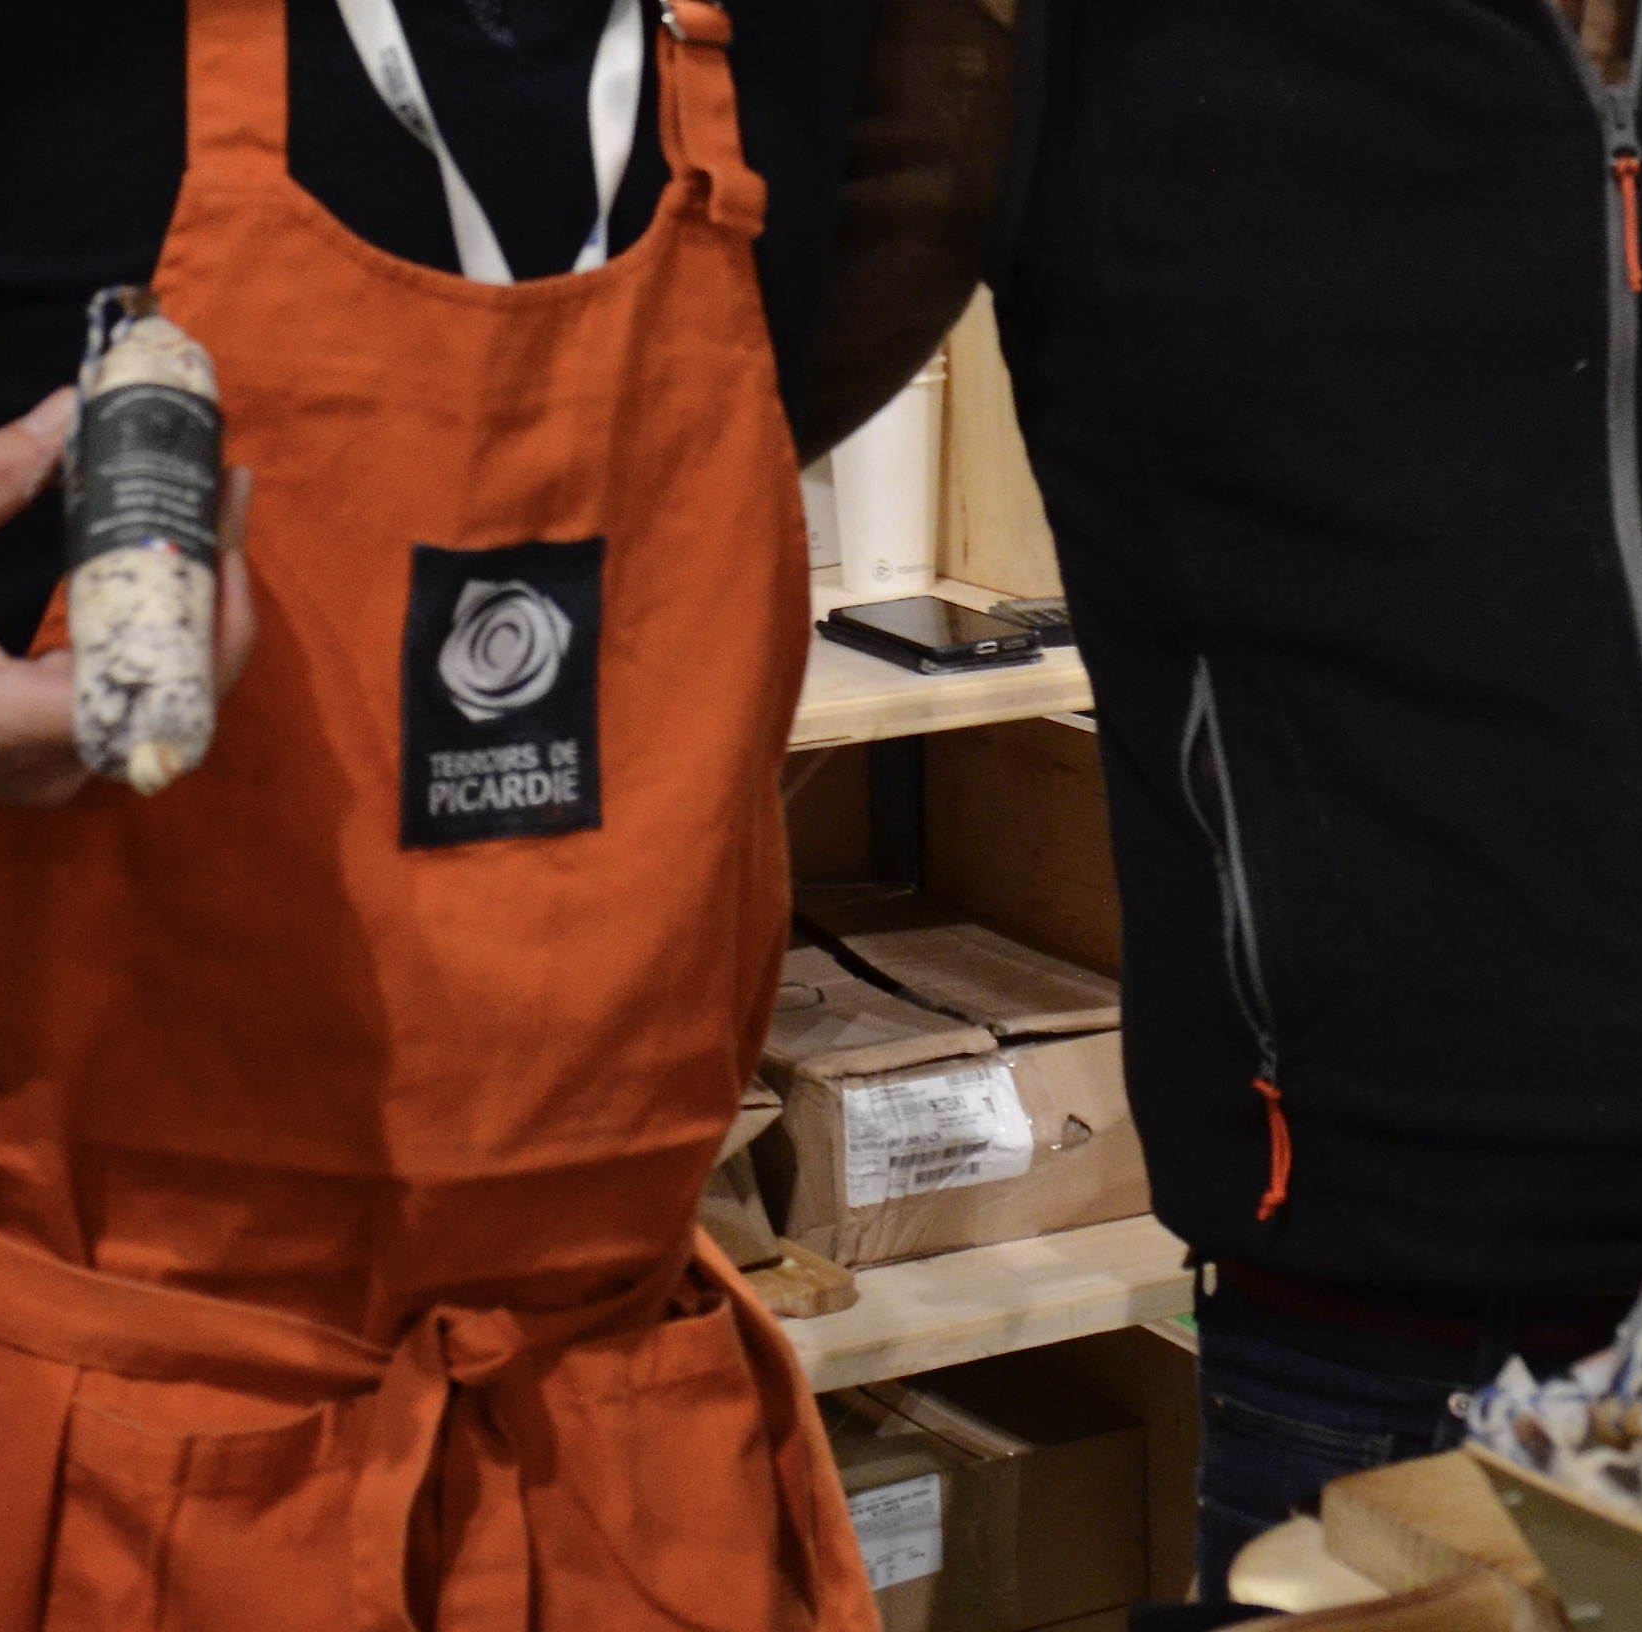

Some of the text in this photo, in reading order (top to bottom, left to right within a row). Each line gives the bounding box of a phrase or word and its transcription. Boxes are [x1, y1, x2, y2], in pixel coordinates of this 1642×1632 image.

[428, 740, 580, 779] TERROIRS DE
[427, 767, 581, 817] PICARDIE
